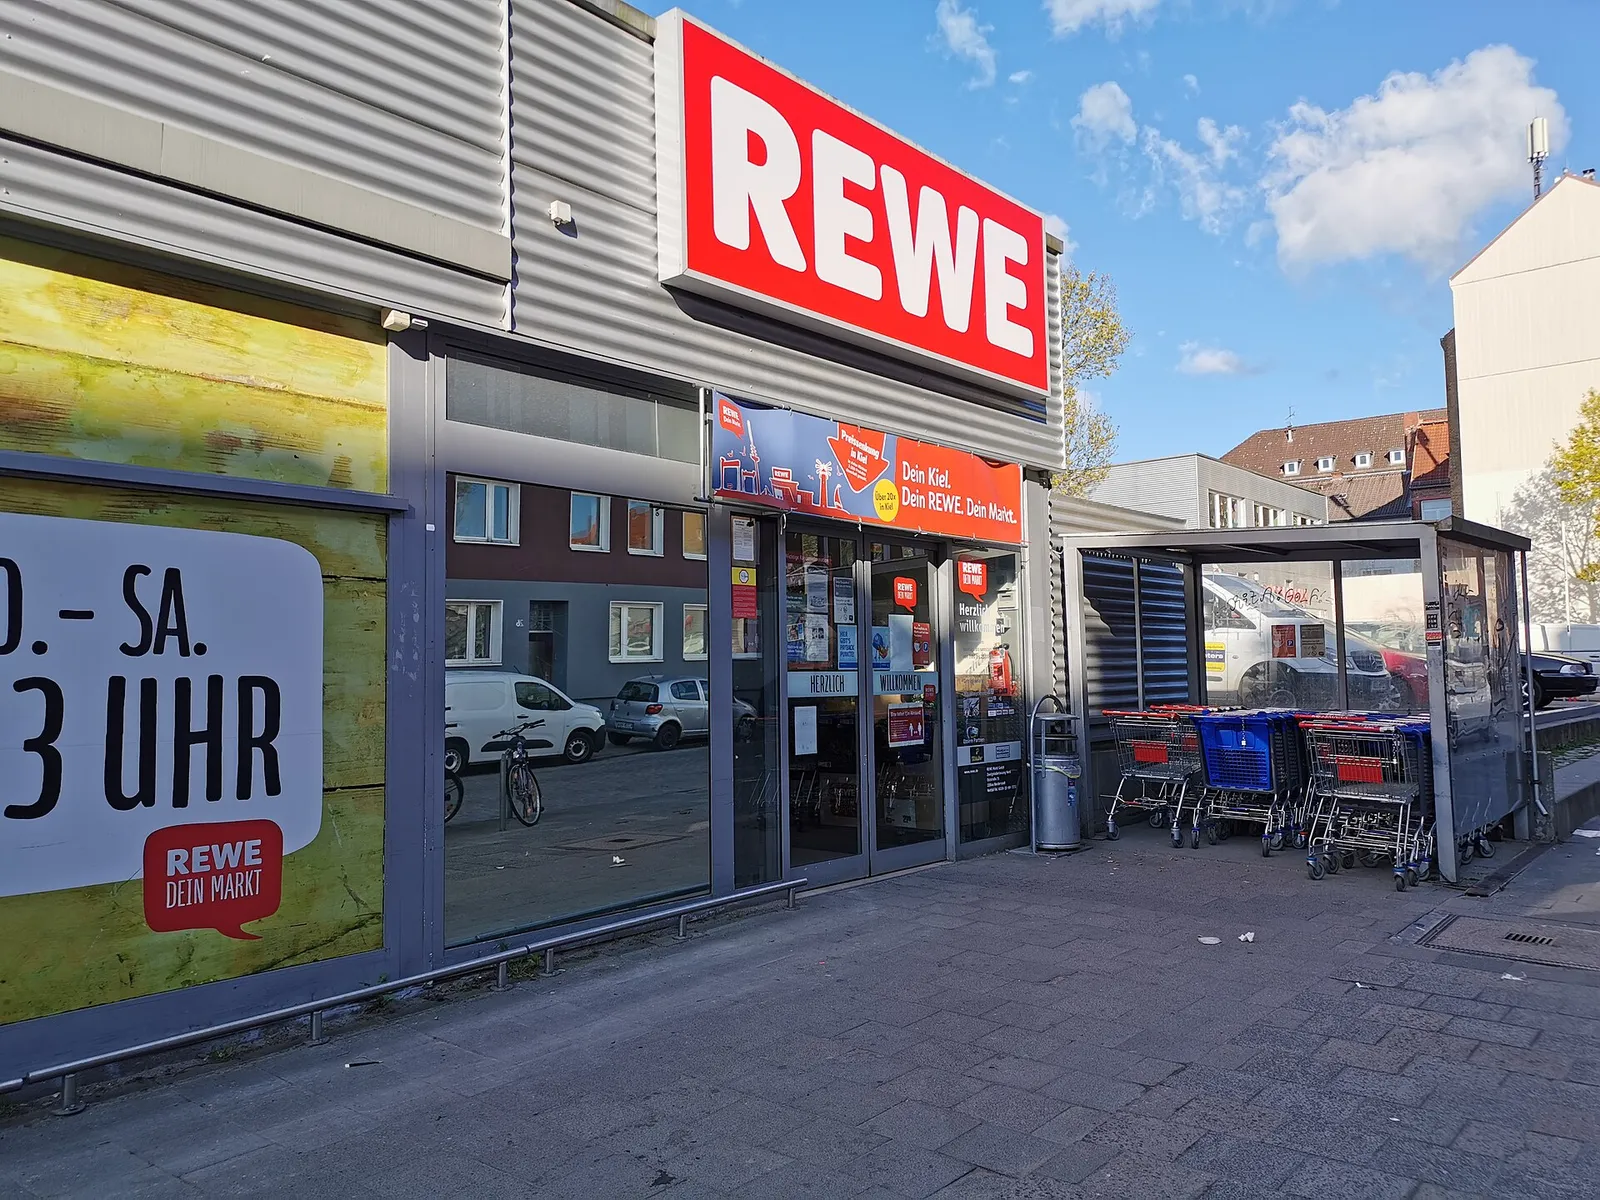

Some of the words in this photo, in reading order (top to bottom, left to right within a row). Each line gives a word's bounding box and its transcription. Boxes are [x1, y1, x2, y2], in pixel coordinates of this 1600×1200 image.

[710, 75, 1034, 358] REWE
[722, 405, 740, 420] REWE
[841, 429, 880, 460] Preissenkung
[857, 450, 868, 464] Kiel
[774, 470, 789, 478] REWE
[902, 460, 925, 484] Dein
[928, 467, 951, 489] Kiel.
[875, 490, 887, 500] Über
[887, 492, 896, 501] 20x
[901, 486, 926, 509] Dein
[928, 491, 964, 515] REWE.
[966, 497, 987, 519] Dein
[989, 502, 1018, 524] Markt.
[884, 503, 894, 511] Kiel
[962, 562, 983, 574] REWE
[897, 583, 913, 592] REWE
[119, 564, 208, 657] SA.
[810, 674, 845, 693] HERZLICH
[880, 674, 922, 691] WILLKOMMEN
[104, 674, 281, 811] UHR
[166, 839, 263, 877] REWE
[166, 879, 204, 909] DEIN
[211, 869, 262, 902] MARKT
